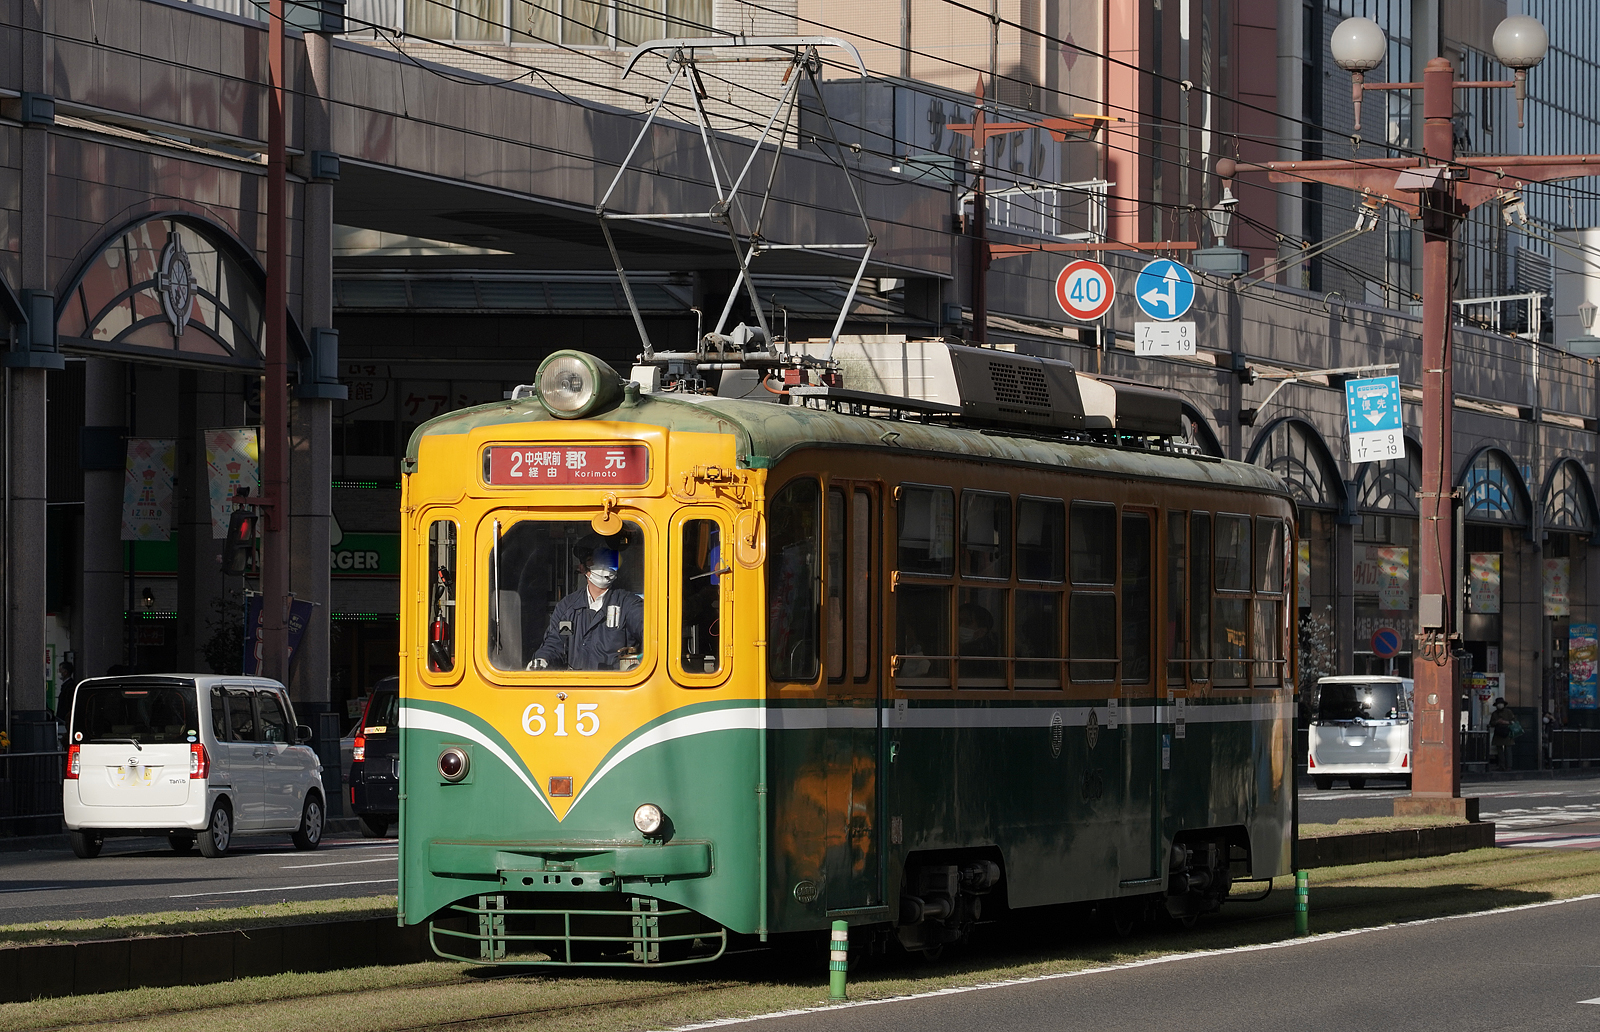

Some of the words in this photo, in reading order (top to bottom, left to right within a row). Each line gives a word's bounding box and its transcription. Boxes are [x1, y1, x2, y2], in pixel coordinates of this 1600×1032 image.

[1070, 277, 1100, 303] 40
[1143, 326, 1151, 338] 7
[1180, 325, 1187, 338] 9
[1140, 339, 1154, 351] 17
[1176, 339, 1190, 351] 19
[1361, 398, 1387, 411] 優先
[1359, 437, 1365, 447] 7
[1388, 434, 1395, 444] 9
[1357, 447, 1368, 458] 17
[1386, 444, 1398, 455] 19
[510, 451, 523, 478] 2
[525, 451, 562, 466] 中央駅前
[565, 451, 627, 470] 郡元
[528, 467, 557, 478] 経由
[575, 470, 617, 478] Korimoto
[131, 509, 162, 517] IZURO
[521, 703, 600, 737] 615
